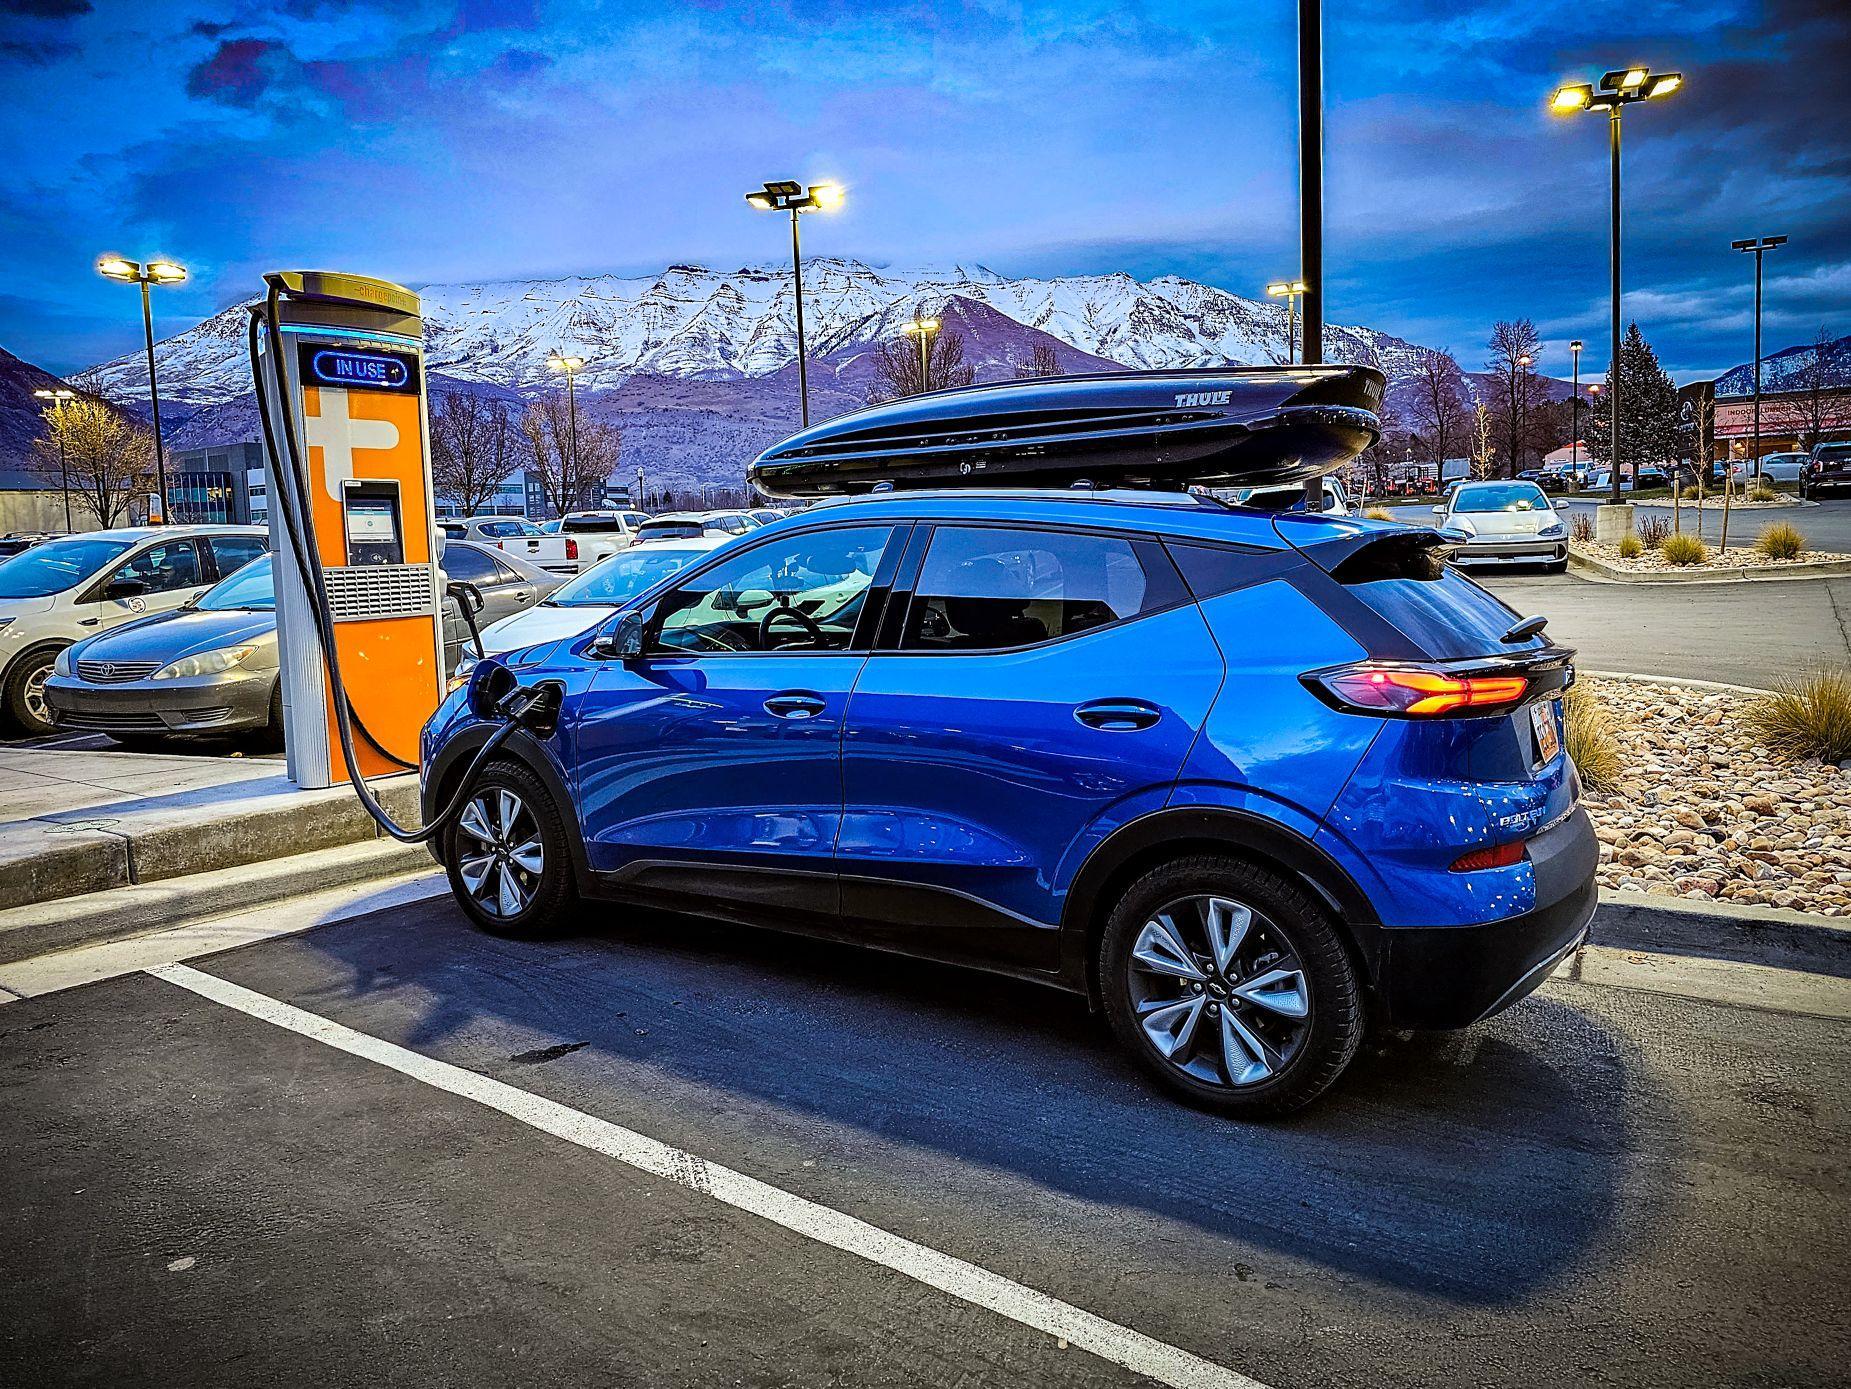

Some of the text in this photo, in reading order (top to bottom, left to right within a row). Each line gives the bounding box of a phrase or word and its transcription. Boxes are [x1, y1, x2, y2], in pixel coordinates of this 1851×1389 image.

[336, 359, 386, 379] IN USE
[1174, 390, 1233, 408] THULE
